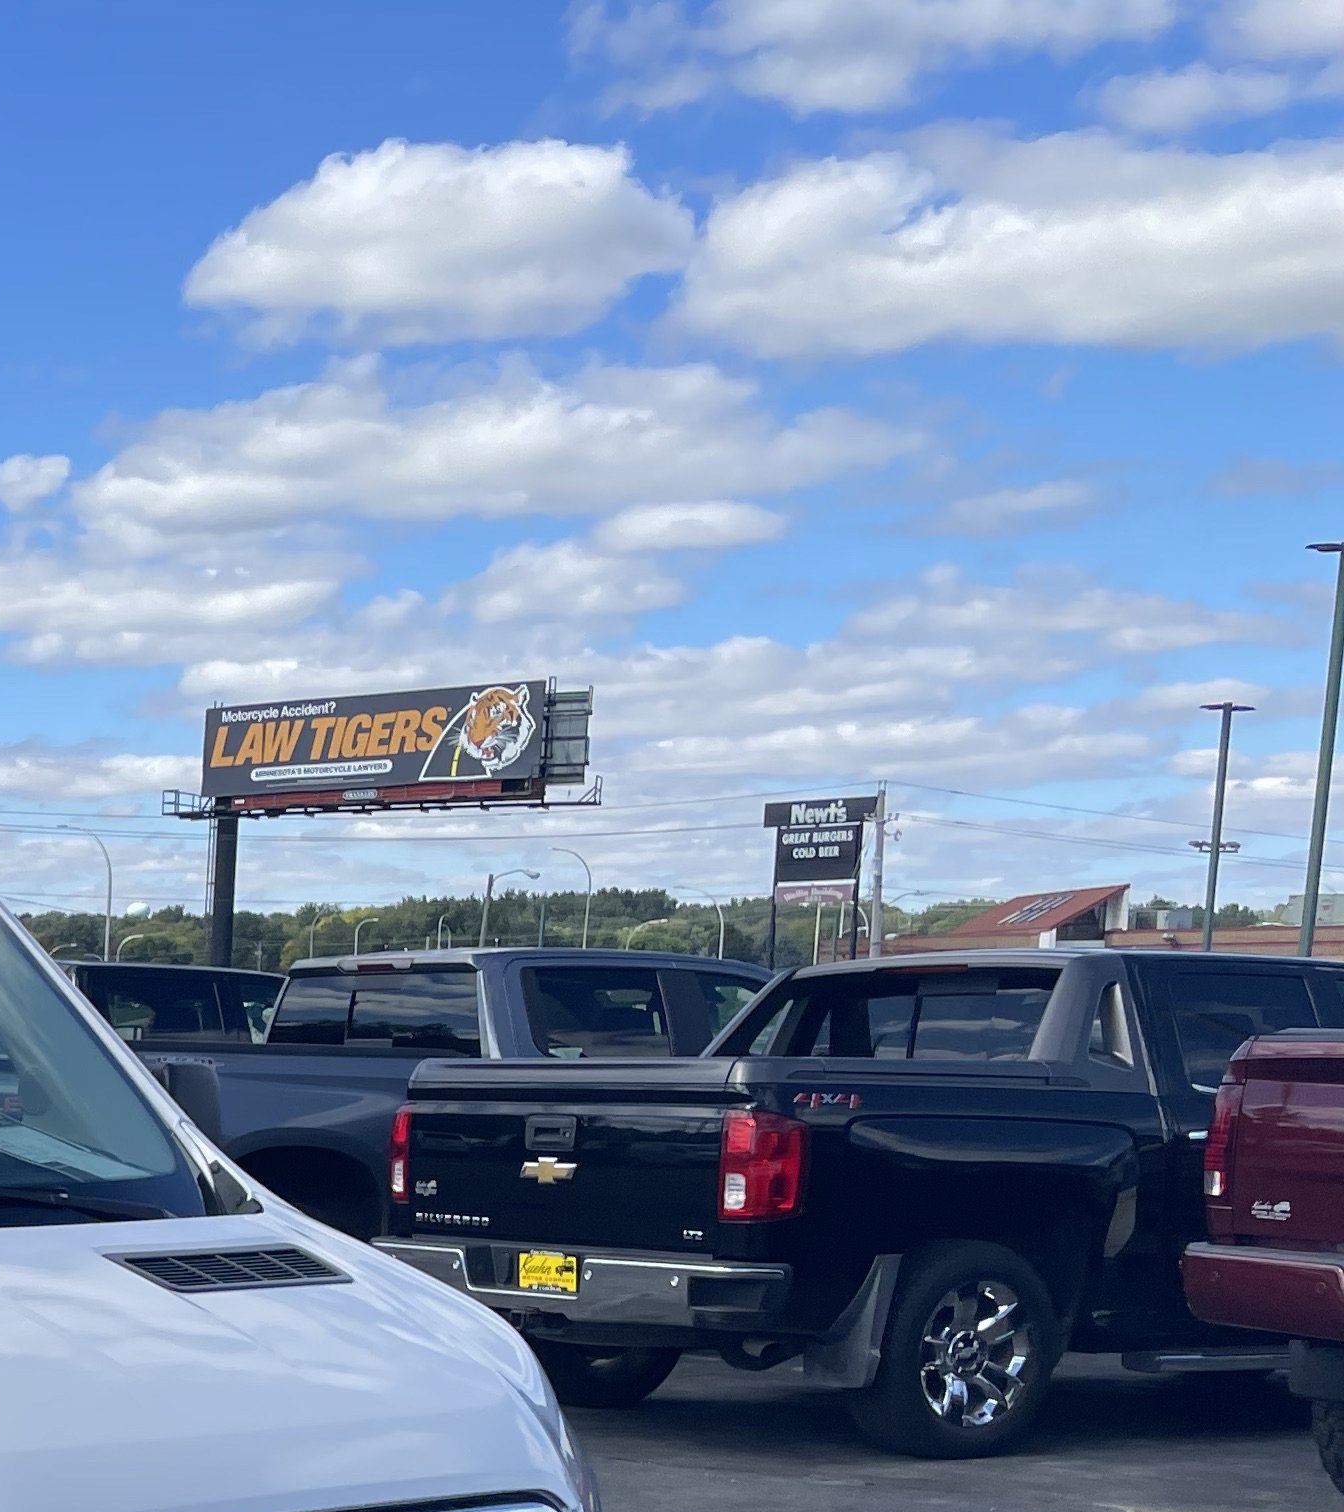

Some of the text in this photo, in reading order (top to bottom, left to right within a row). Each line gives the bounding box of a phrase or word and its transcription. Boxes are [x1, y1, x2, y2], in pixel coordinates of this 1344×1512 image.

[222, 701, 337, 723] Motorcycle Accident?
[210, 706, 448, 768] LAW TIGERS
[255, 762, 388, 778] MINNESOTA'S MOTORCYCLE LAWYERS
[790, 800, 847, 824] Newt's
[782, 830, 854, 845] GREAT BURGERS
[792, 846, 839, 859] COLD BEER
[415, 1212, 490, 1226] SILVERADO
